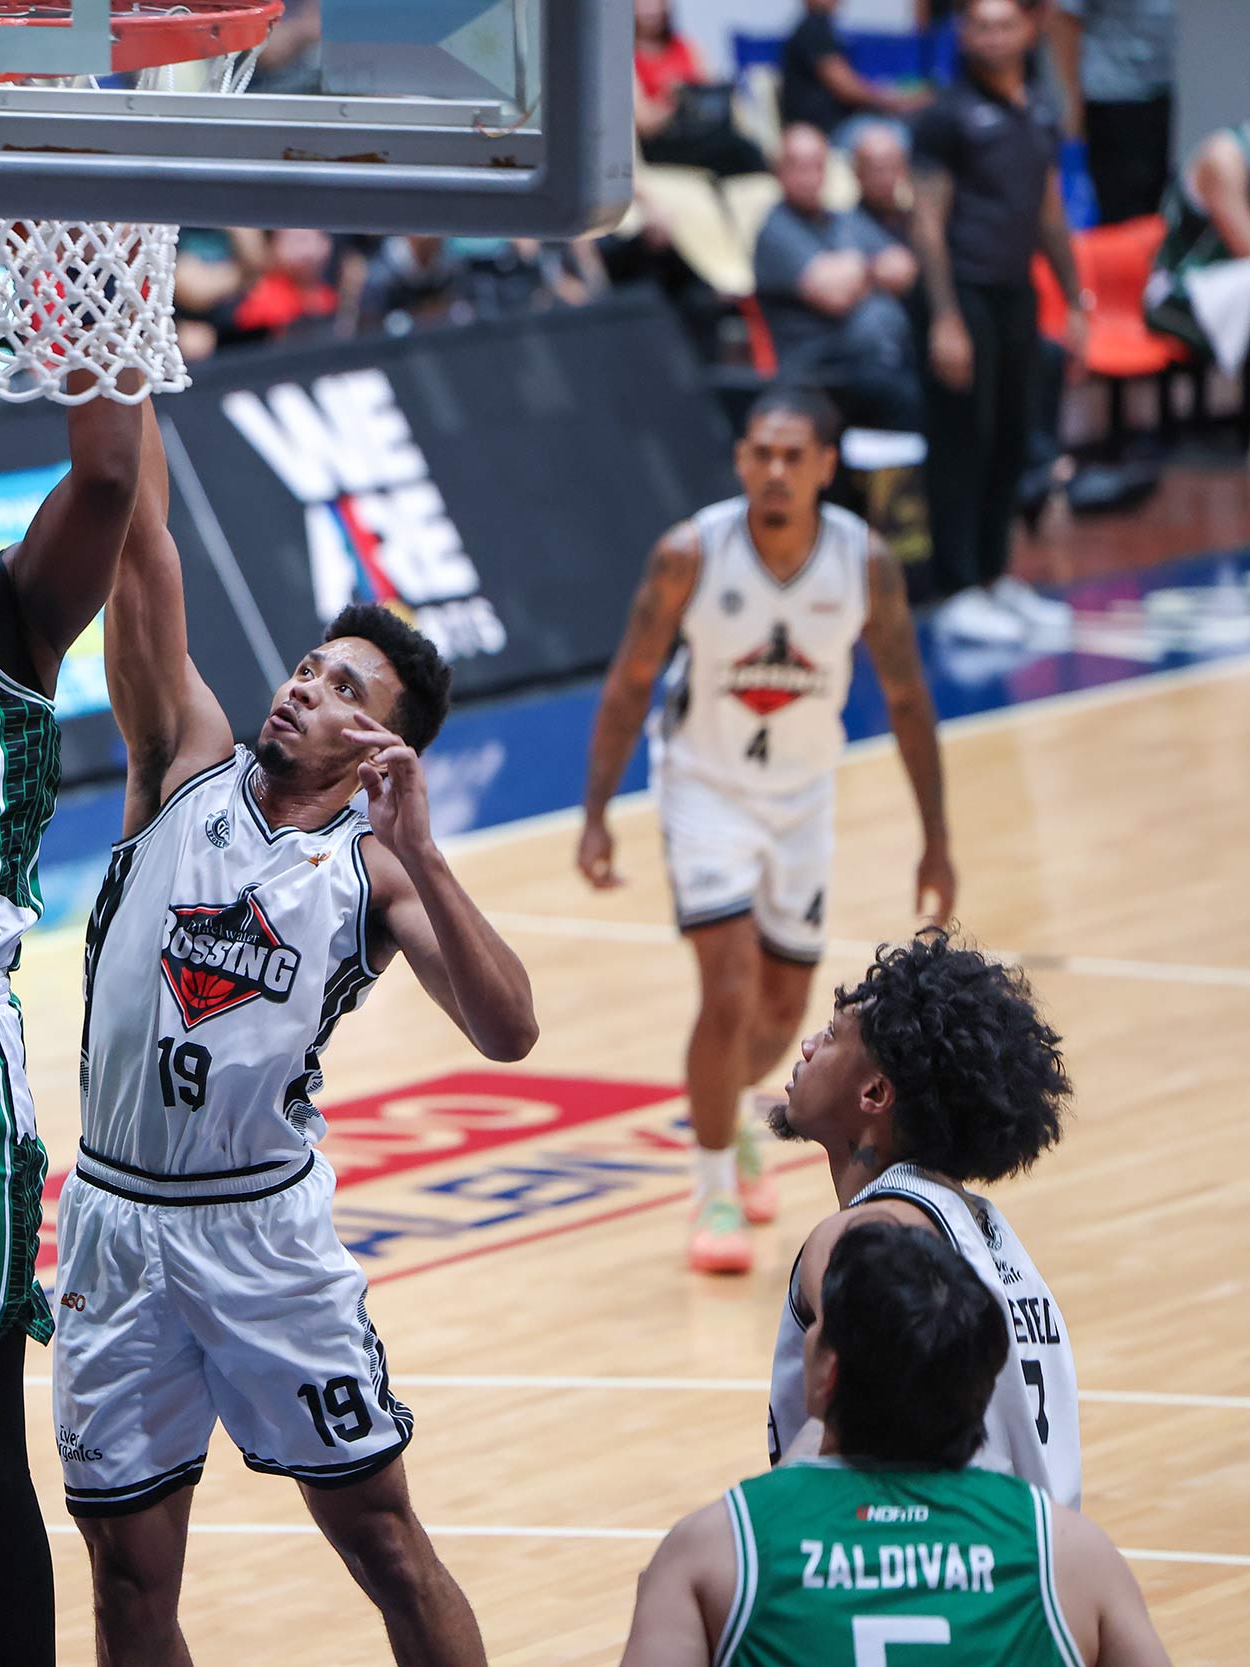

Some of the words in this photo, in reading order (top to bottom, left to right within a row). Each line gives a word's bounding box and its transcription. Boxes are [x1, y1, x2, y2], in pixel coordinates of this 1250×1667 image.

[220, 367, 429, 504] WE
[744, 723, 770, 768] 4
[804, 886, 825, 928] 4
[161, 906, 299, 993] BOSSING
[157, 1036, 213, 1112] 19
[297, 1375, 373, 1448] 19
[1020, 1359, 1049, 1445] 7
[800, 1538, 995, 1593] ZALDIVAR
